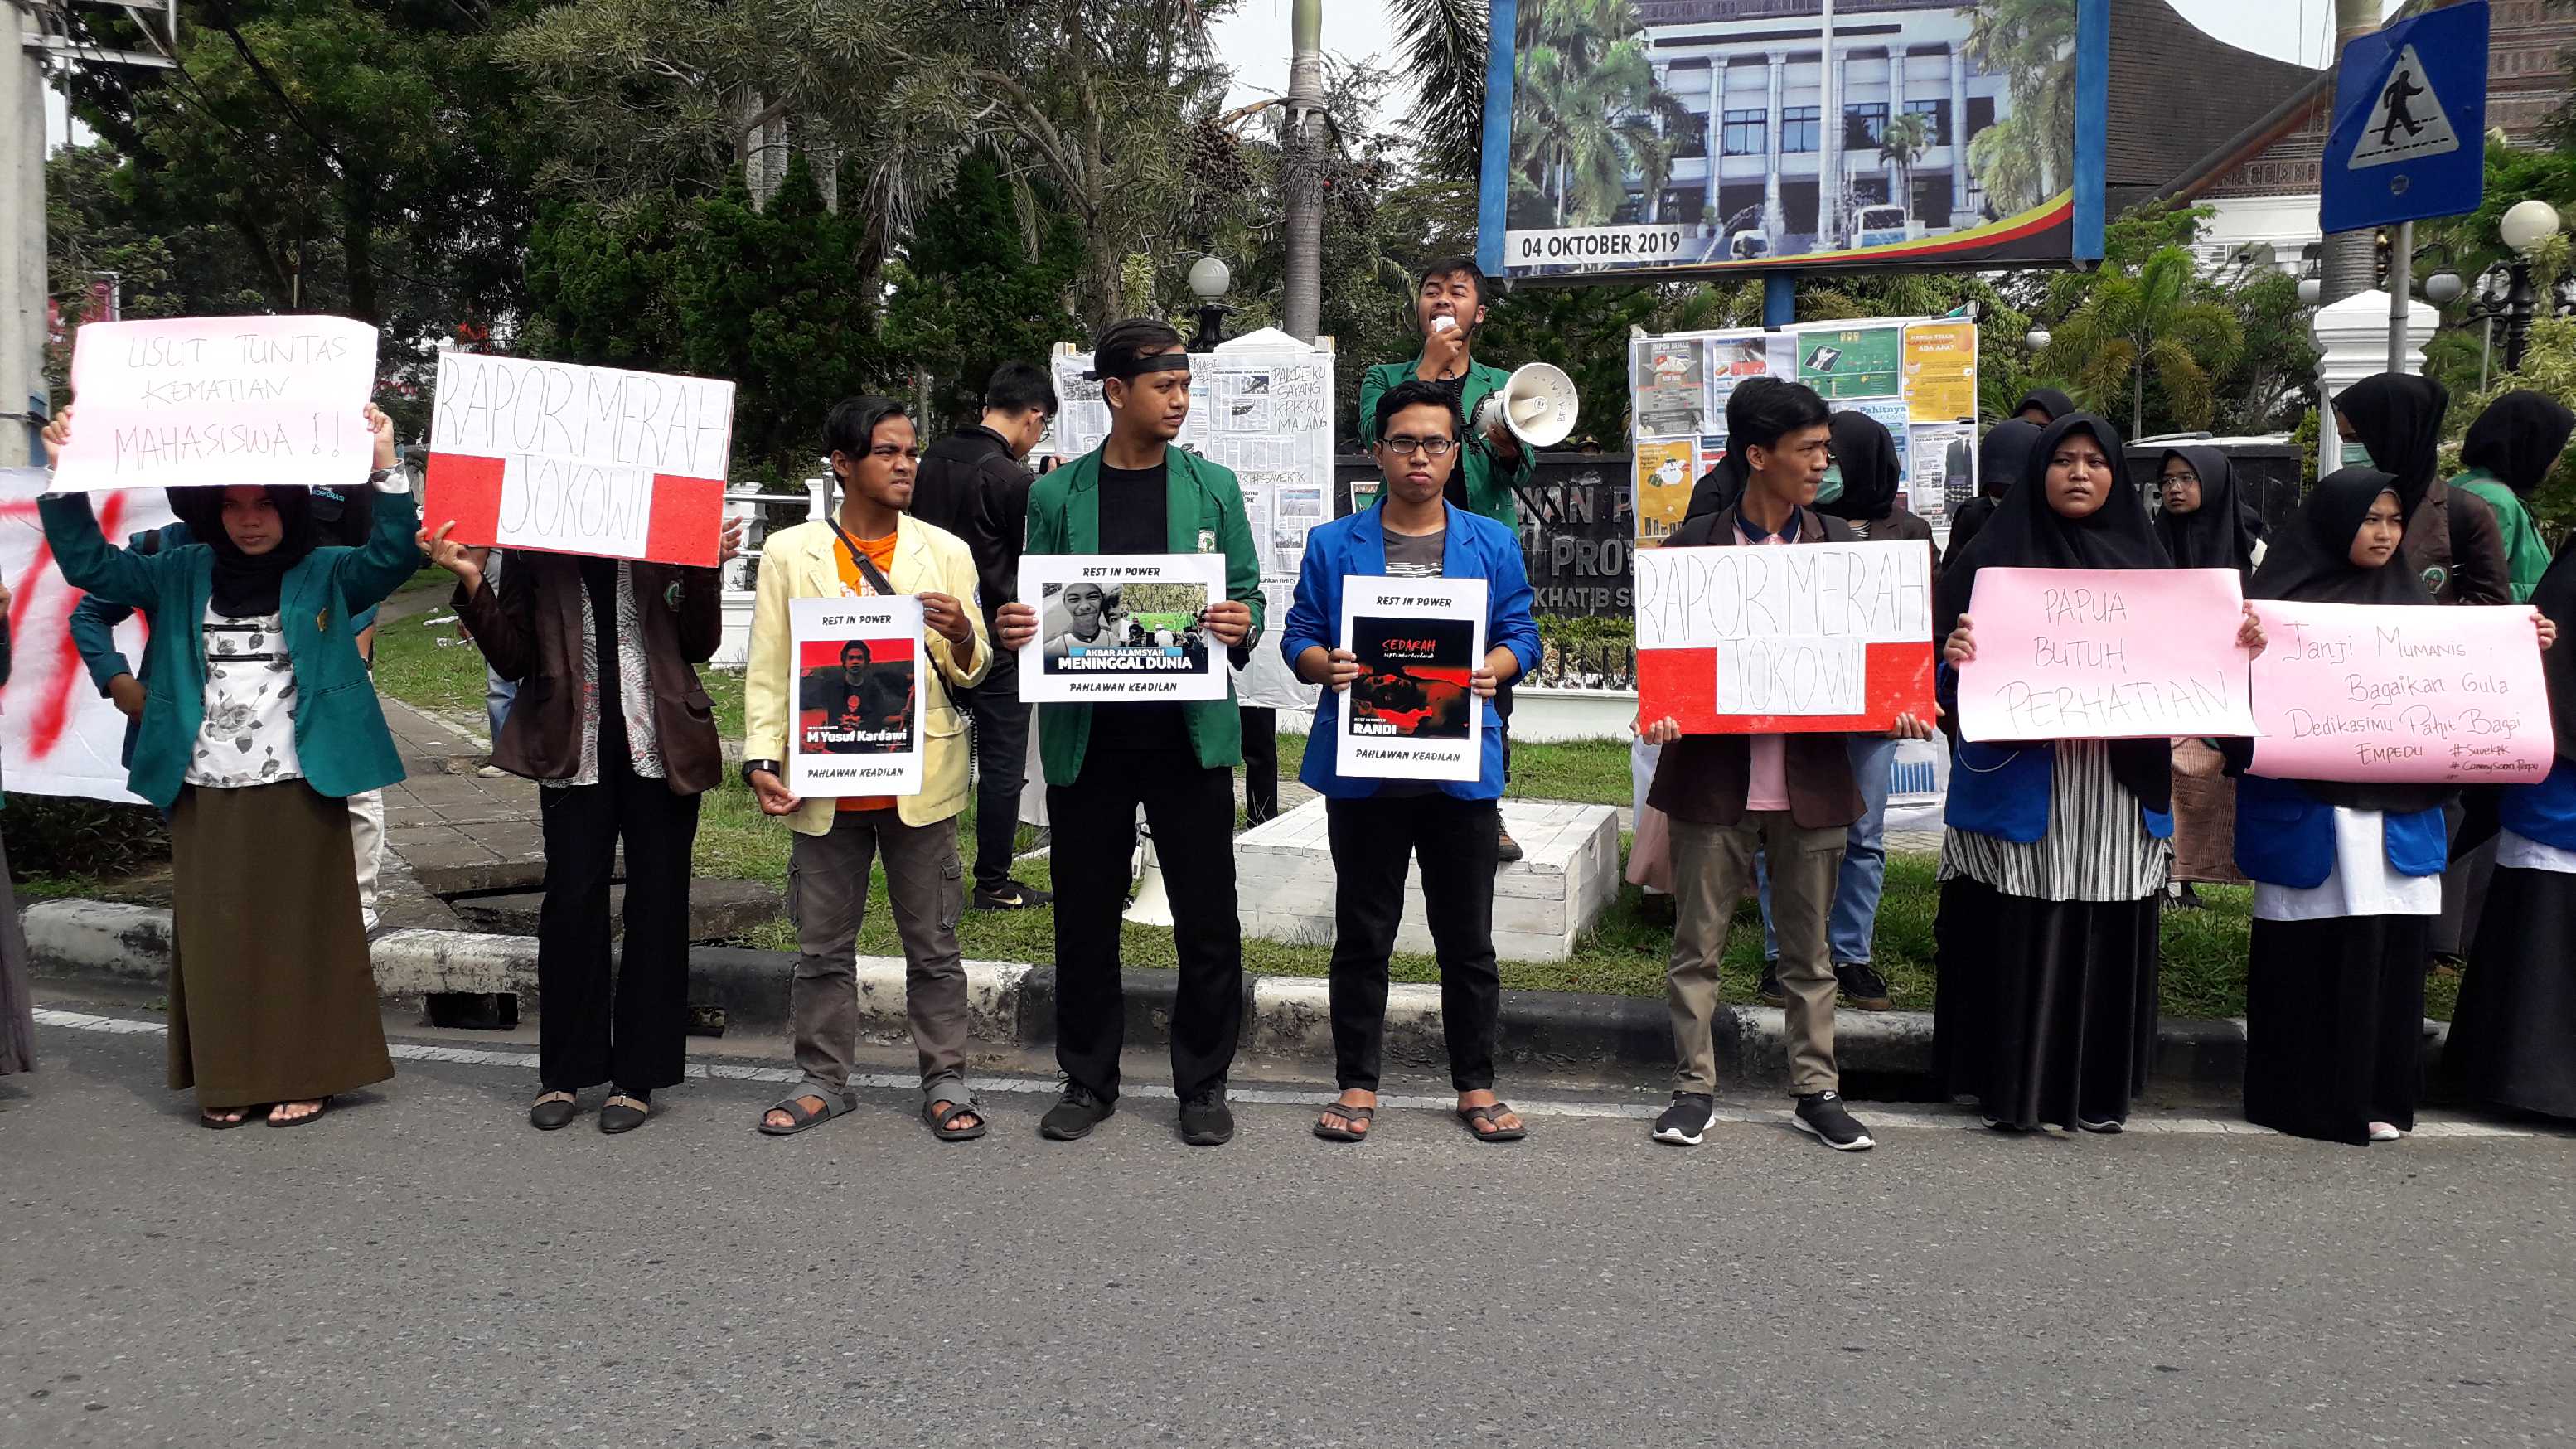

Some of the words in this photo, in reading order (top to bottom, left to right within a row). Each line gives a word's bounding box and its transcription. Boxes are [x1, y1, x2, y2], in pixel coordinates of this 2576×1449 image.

[1522, 237, 1542, 258] 04
[1547, 234, 1632, 257] OKTOBER
[1639, 231, 1681, 254] 2019
[128, 336, 209, 367] USUT
[235, 333, 348, 366] TUNTAS
[141, 376, 290, 410] KEMATIAN
[437, 357, 574, 453] RAPOR
[583, 371, 729, 475] MERAH
[114, 420, 293, 474] MAHASISWA
[500, 454, 646, 541] JOKOWI
[1083, 567, 1108, 577] REST
[1110, 567, 1121, 576] IN
[1125, 567, 1160, 577] POWER
[1376, 596, 1401, 606] REST
[1402, 597, 1414, 606] IN
[1416, 597, 1452, 608] POWER
[1533, 587, 1610, 608] KHATIB
[1638, 554, 1779, 644] RAPOR
[1786, 550, 1925, 637] MERAH
[2043, 588, 2127, 626] PAPUA
[822, 616, 844, 626] REST
[846, 616, 856, 625] IN
[859, 615, 892, 624] POWER
[1085, 648, 1116, 657] AKBAR
[1116, 648, 1165, 657] ALAMSYAH
[1382, 638, 1437, 652] SEDARAH
[2034, 637, 2127, 674] BUTUH
[2282, 620, 2354, 665] Janji
[1058, 657, 1145, 670] MENINGGAL
[1145, 657, 1193, 669] DUNIA
[1718, 637, 1860, 713] JOKOWI
[1070, 683, 1125, 692] PAHLAWAN
[1128, 682, 1177, 691] KEADILAN
[2344, 673, 2448, 710] Bagaikan
[2462, 673, 2511, 694] Gula
[1995, 670, 2229, 735] PERHATIAN
[807, 731, 819, 742] M
[820, 731, 855, 742] Yusuf
[857, 729, 908, 742] Kardawi
[1353, 723, 1397, 735] RANDI
[2458, 708, 2521, 739] Bagai
[1356, 749, 1409, 760] PAHLAWAN
[1412, 751, 1460, 762] KEADILAN
[2356, 742, 2423, 766] EMPEDU
[807, 768, 857, 778] PAHLAWAN
[859, 768, 905, 778] KEADILAN
